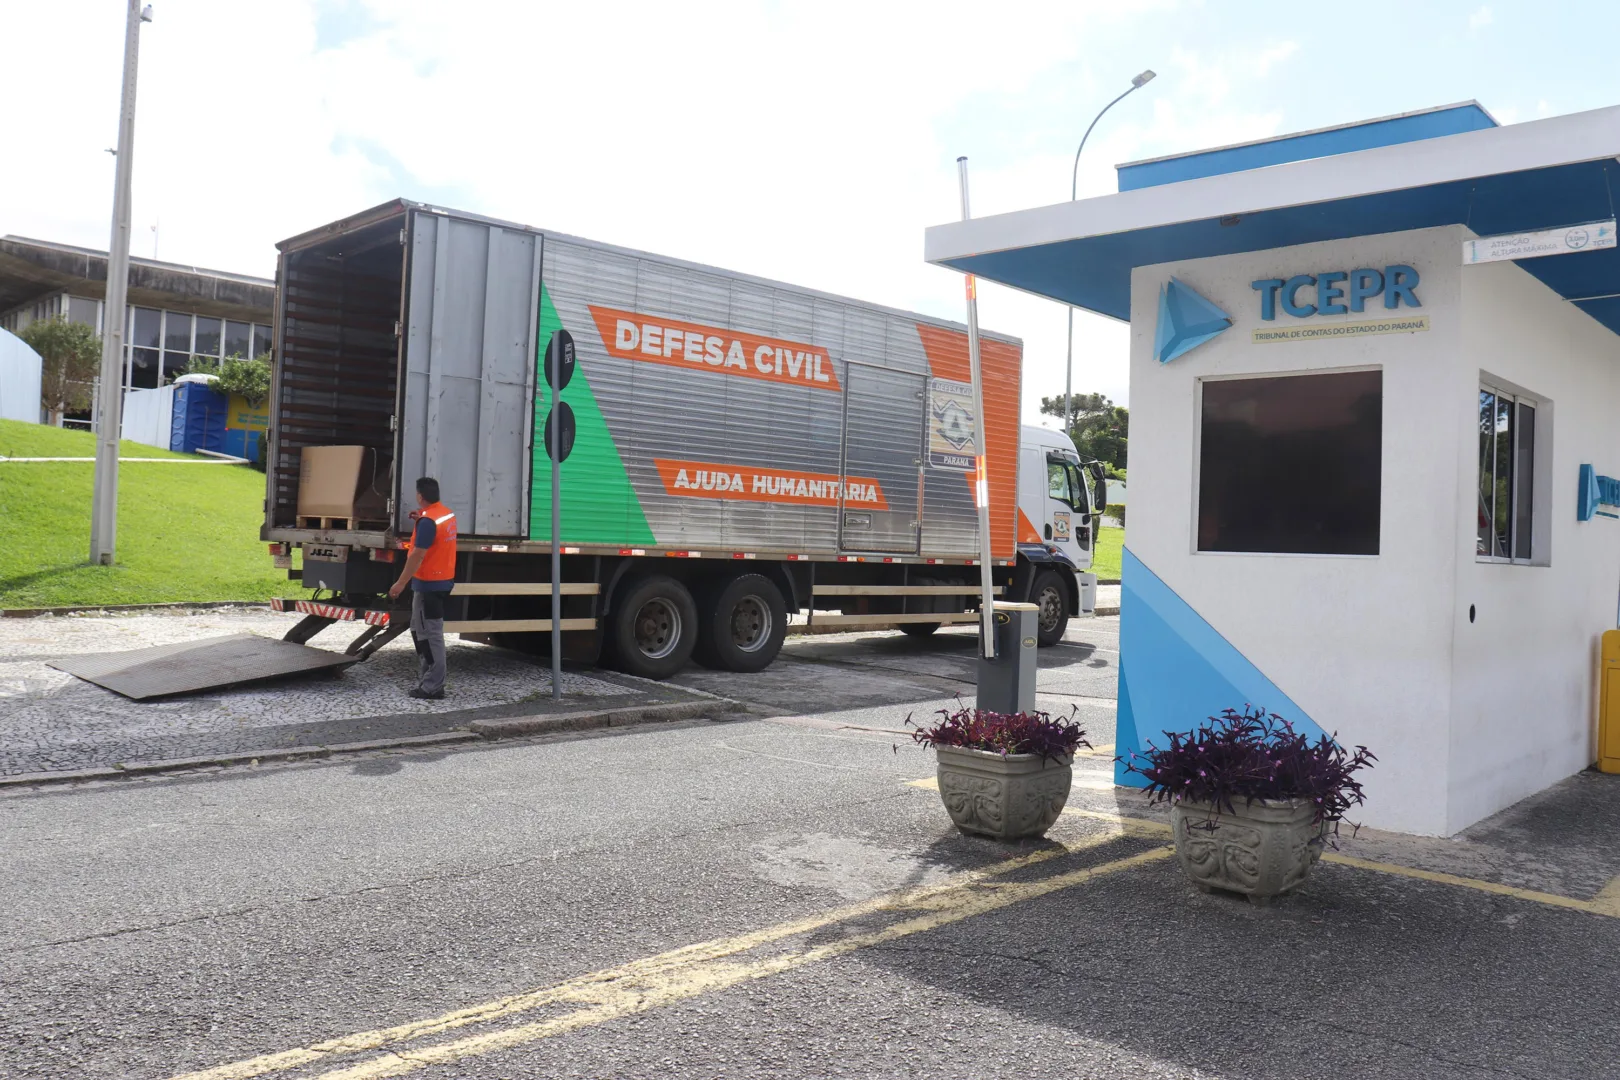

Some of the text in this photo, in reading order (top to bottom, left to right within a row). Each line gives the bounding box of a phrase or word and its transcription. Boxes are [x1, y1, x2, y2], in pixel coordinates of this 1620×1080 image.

[1490, 238, 1530, 248] ATENÇÃO
[1491, 243, 1558, 257] ALTURA MÁXIMA
[1252, 264, 1422, 321] TCEPR
[1255, 320, 1424, 340] TRIBUNAL DE CONTAS DO ESTADO DO PARANÁ
[615, 319, 748, 370] DEFESA
[754, 344, 830, 383] CIVIL
[935, 383, 960, 394] DEFESA
[674, 468, 744, 493] AJUDA
